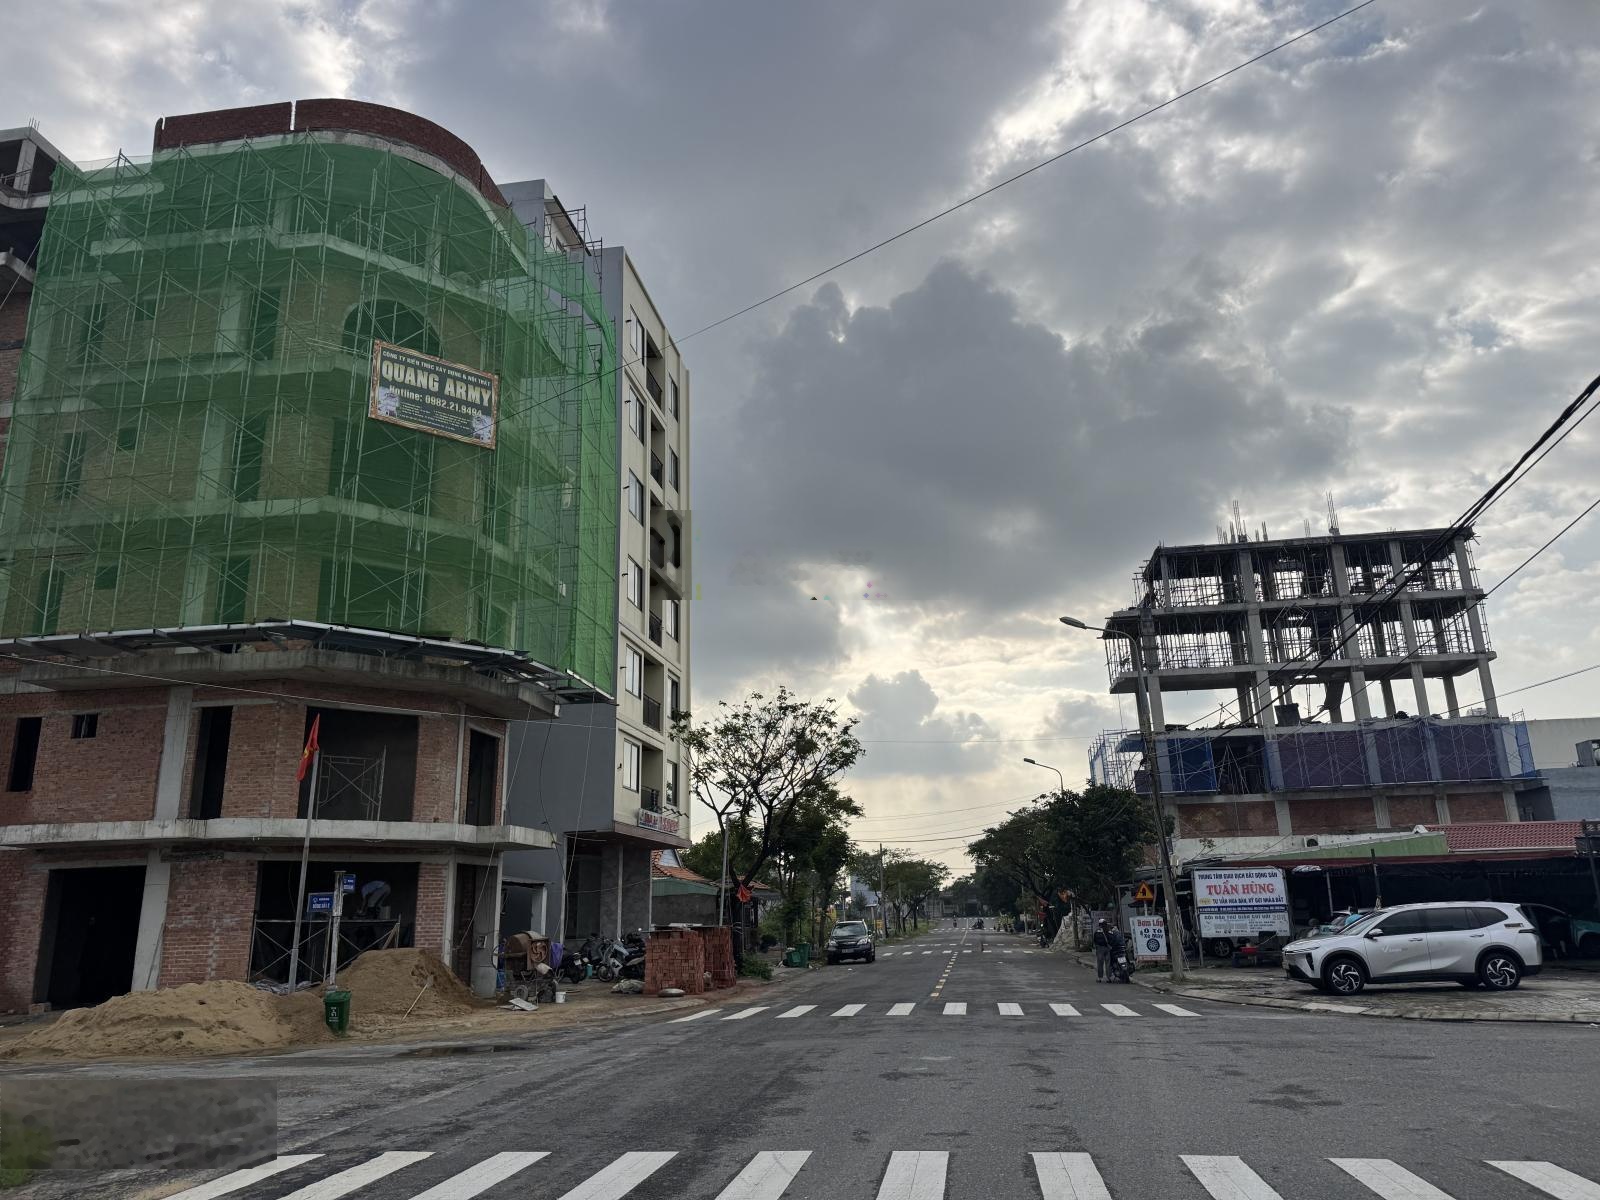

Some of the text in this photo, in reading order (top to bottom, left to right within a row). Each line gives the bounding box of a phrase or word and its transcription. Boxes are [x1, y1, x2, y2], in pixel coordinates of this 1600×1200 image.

[381, 360, 492, 407] QUANG ARMY
[389, 385, 423, 402] Hotline:
[1241, 881, 1275, 894] HÙNG
